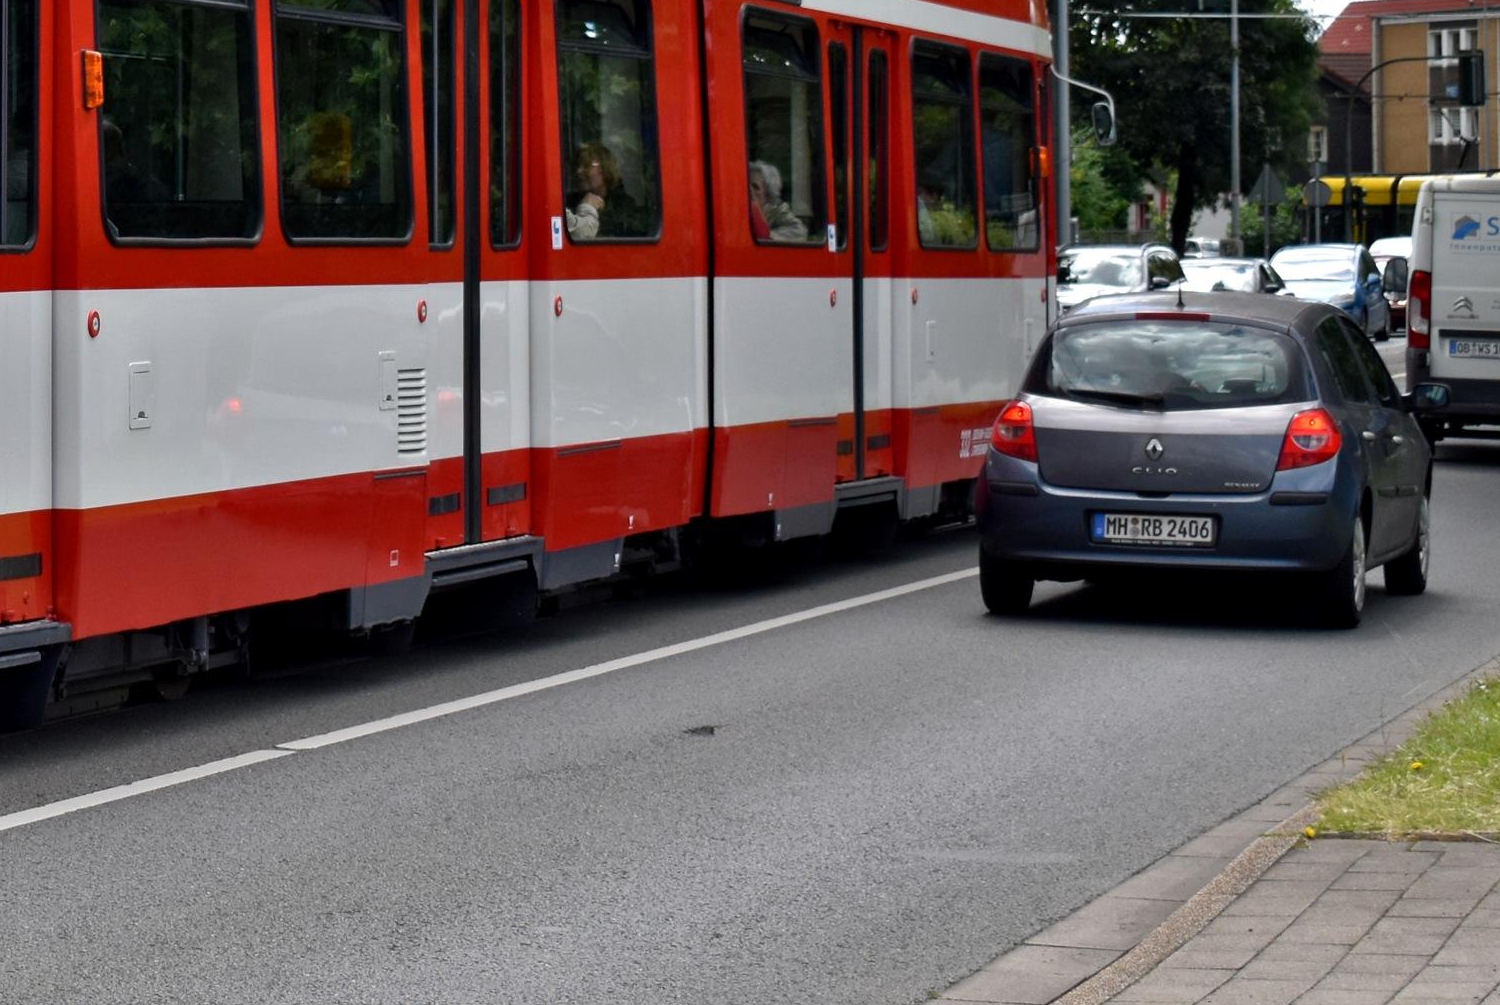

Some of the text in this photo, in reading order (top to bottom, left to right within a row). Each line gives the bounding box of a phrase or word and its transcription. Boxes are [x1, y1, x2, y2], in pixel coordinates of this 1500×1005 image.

[1106, 514, 1210, 539] MH RB 2406
